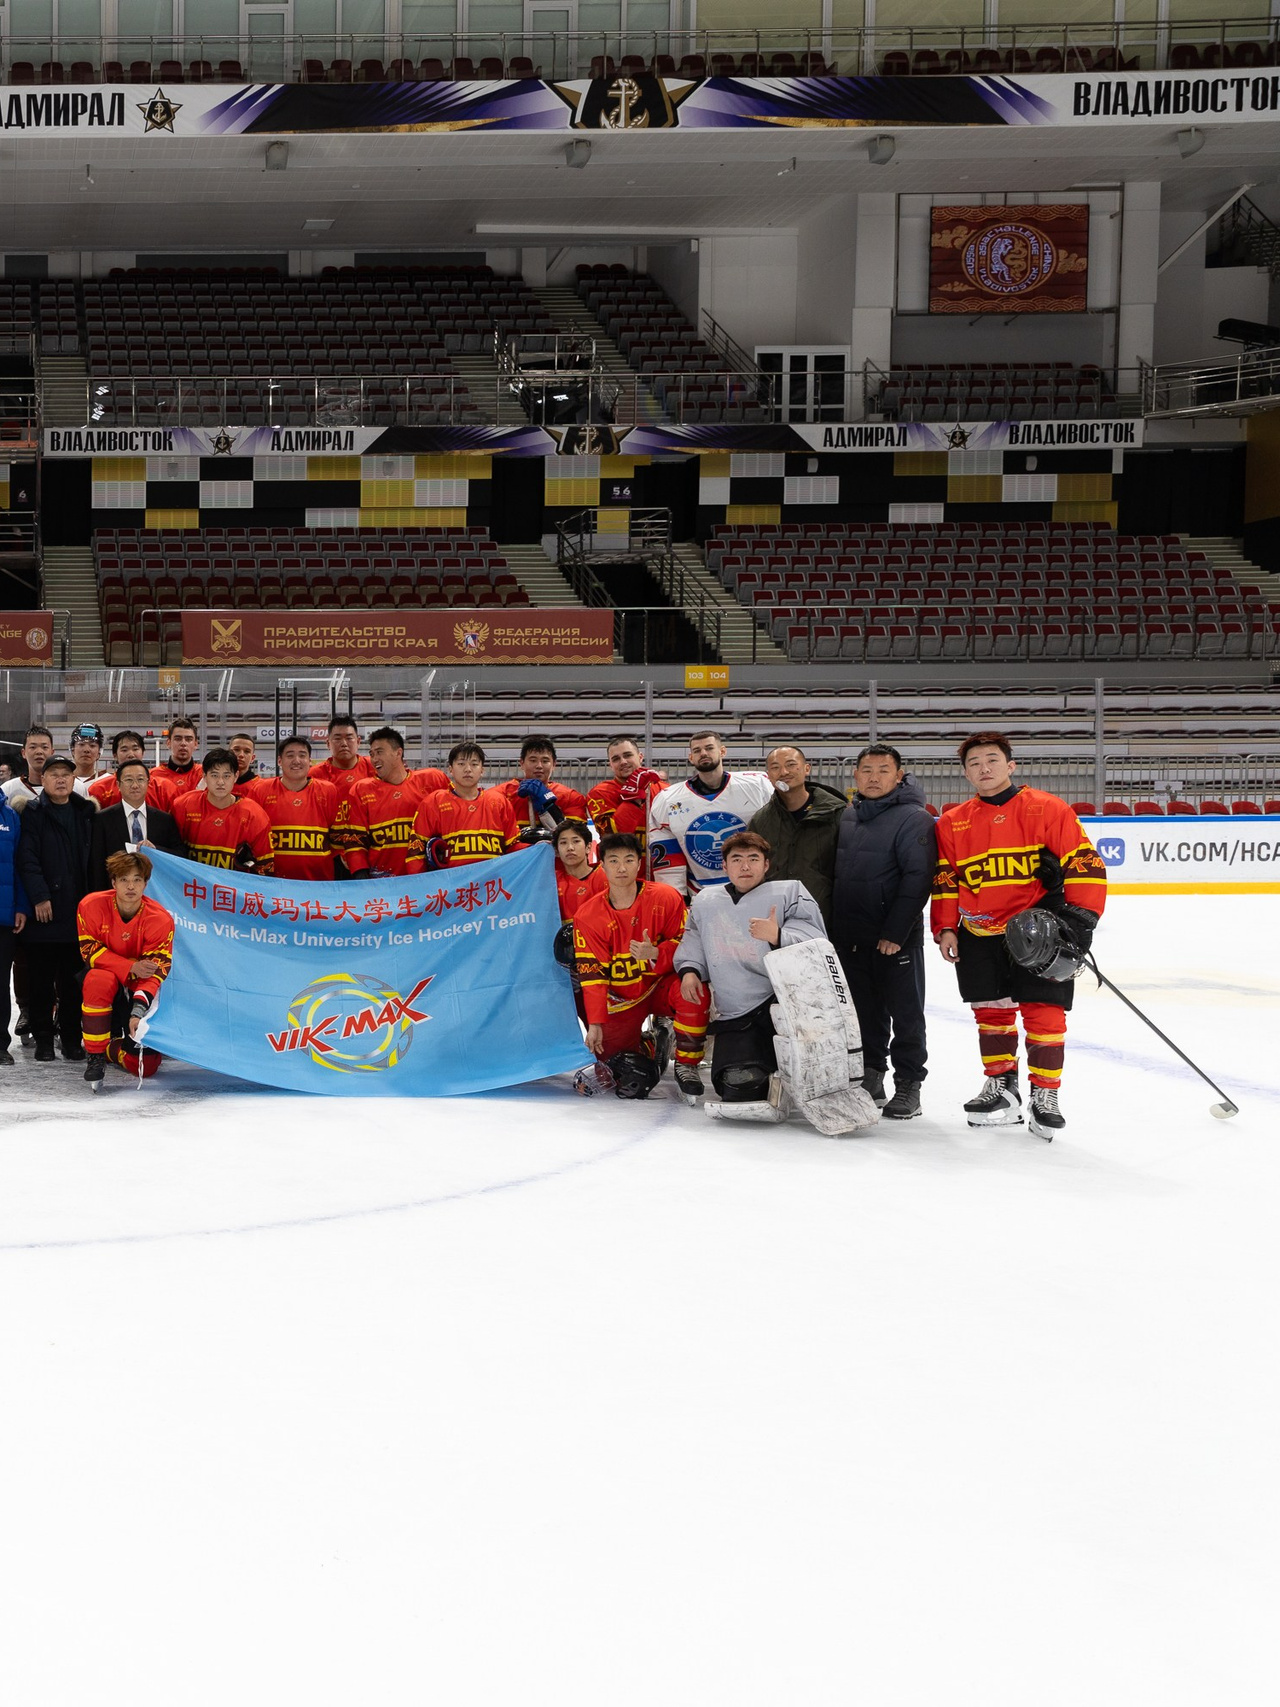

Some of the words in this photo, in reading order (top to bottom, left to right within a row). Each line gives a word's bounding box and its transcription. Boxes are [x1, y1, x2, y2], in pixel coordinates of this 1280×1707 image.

[50, 431, 174, 453] ВЛАДИВОСТОК
[271, 430, 355, 452] АДМИРАЛ
[822, 426, 908, 449] АДМИРАЛ
[1008, 420, 1135, 446] ВЛАДИВОСТОК
[263, 626, 406, 637] ПРАВИТЕЛЬСТВО
[493, 627, 581, 637] ФЕДЕРАЦИЯ
[493, 637, 549, 647] ХОККЕЯ
[552, 637, 610, 647] РОССИИ
[263, 638, 389, 649] ПРИМОРСКОГО
[393, 638, 438, 649] КРАЯ
[688, 672, 704, 680] 103
[709, 672, 726, 680] 104
[183, 877, 513, 924] 中国威玛仕大学生冰球队
[293, 930, 383, 949] University
[388, 931, 413, 944] Ice
[418, 920, 482, 944] Hockey
[486, 910, 537, 931] Team
[265, 974, 437, 1056] VIK-MAX
